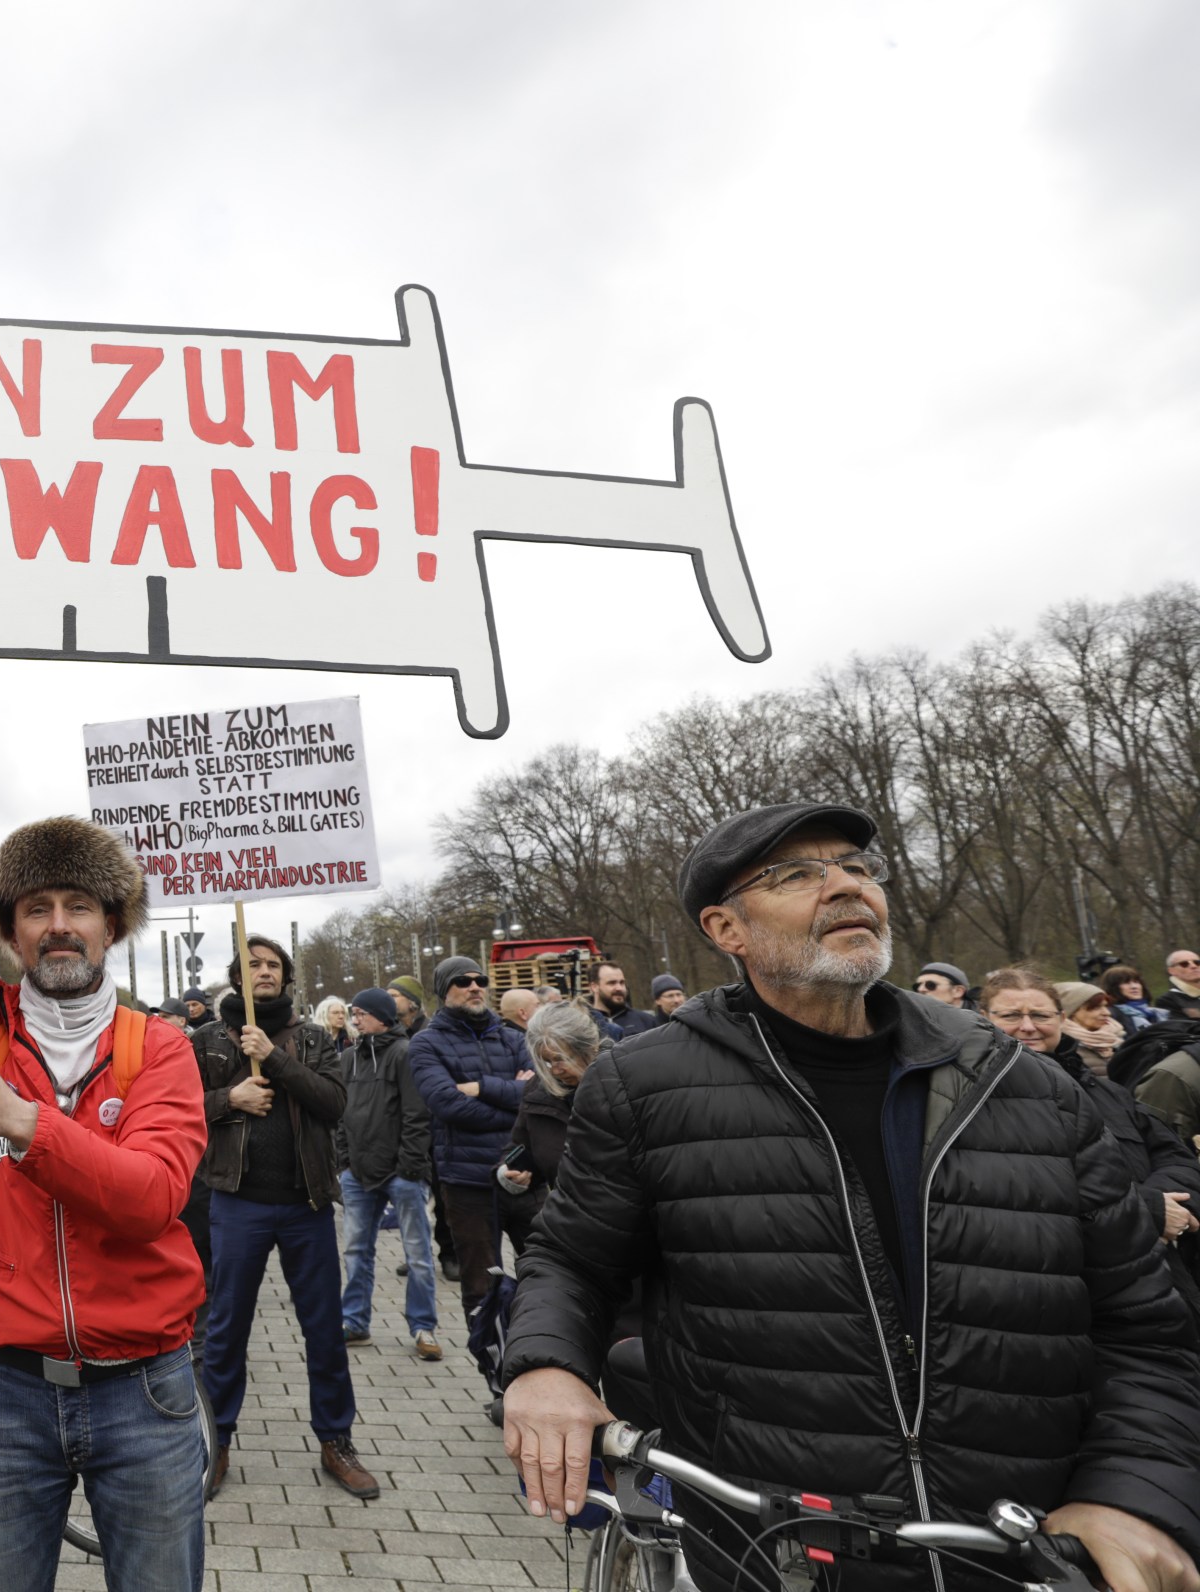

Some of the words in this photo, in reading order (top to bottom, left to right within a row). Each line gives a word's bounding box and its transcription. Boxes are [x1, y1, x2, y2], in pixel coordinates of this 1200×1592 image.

[91, 343, 361, 455] ZUM
[146, 713, 210, 740] NEIN
[225, 705, 289, 732] ZUM
[87, 763, 150, 787] FREIHEIT
[151, 760, 189, 779] durch
[195, 744, 355, 776] SELBSTBESTIMMUNG
[199, 772, 272, 795] STATT
[92, 804, 171, 826] BINDENDE
[179, 786, 360, 821] FREMDBESTIMMUNG
[134, 821, 183, 852] WHO
[262, 818, 276, 834] &
[278, 814, 307, 833] BILL
[310, 810, 365, 832] GATES)
[135, 854, 177, 876] SIND
[181, 851, 223, 875] KEIN
[228, 845, 277, 869] VIEH
[162, 875, 195, 896] DER
[201, 861, 368, 893] PHARMAINDUSTRIE
